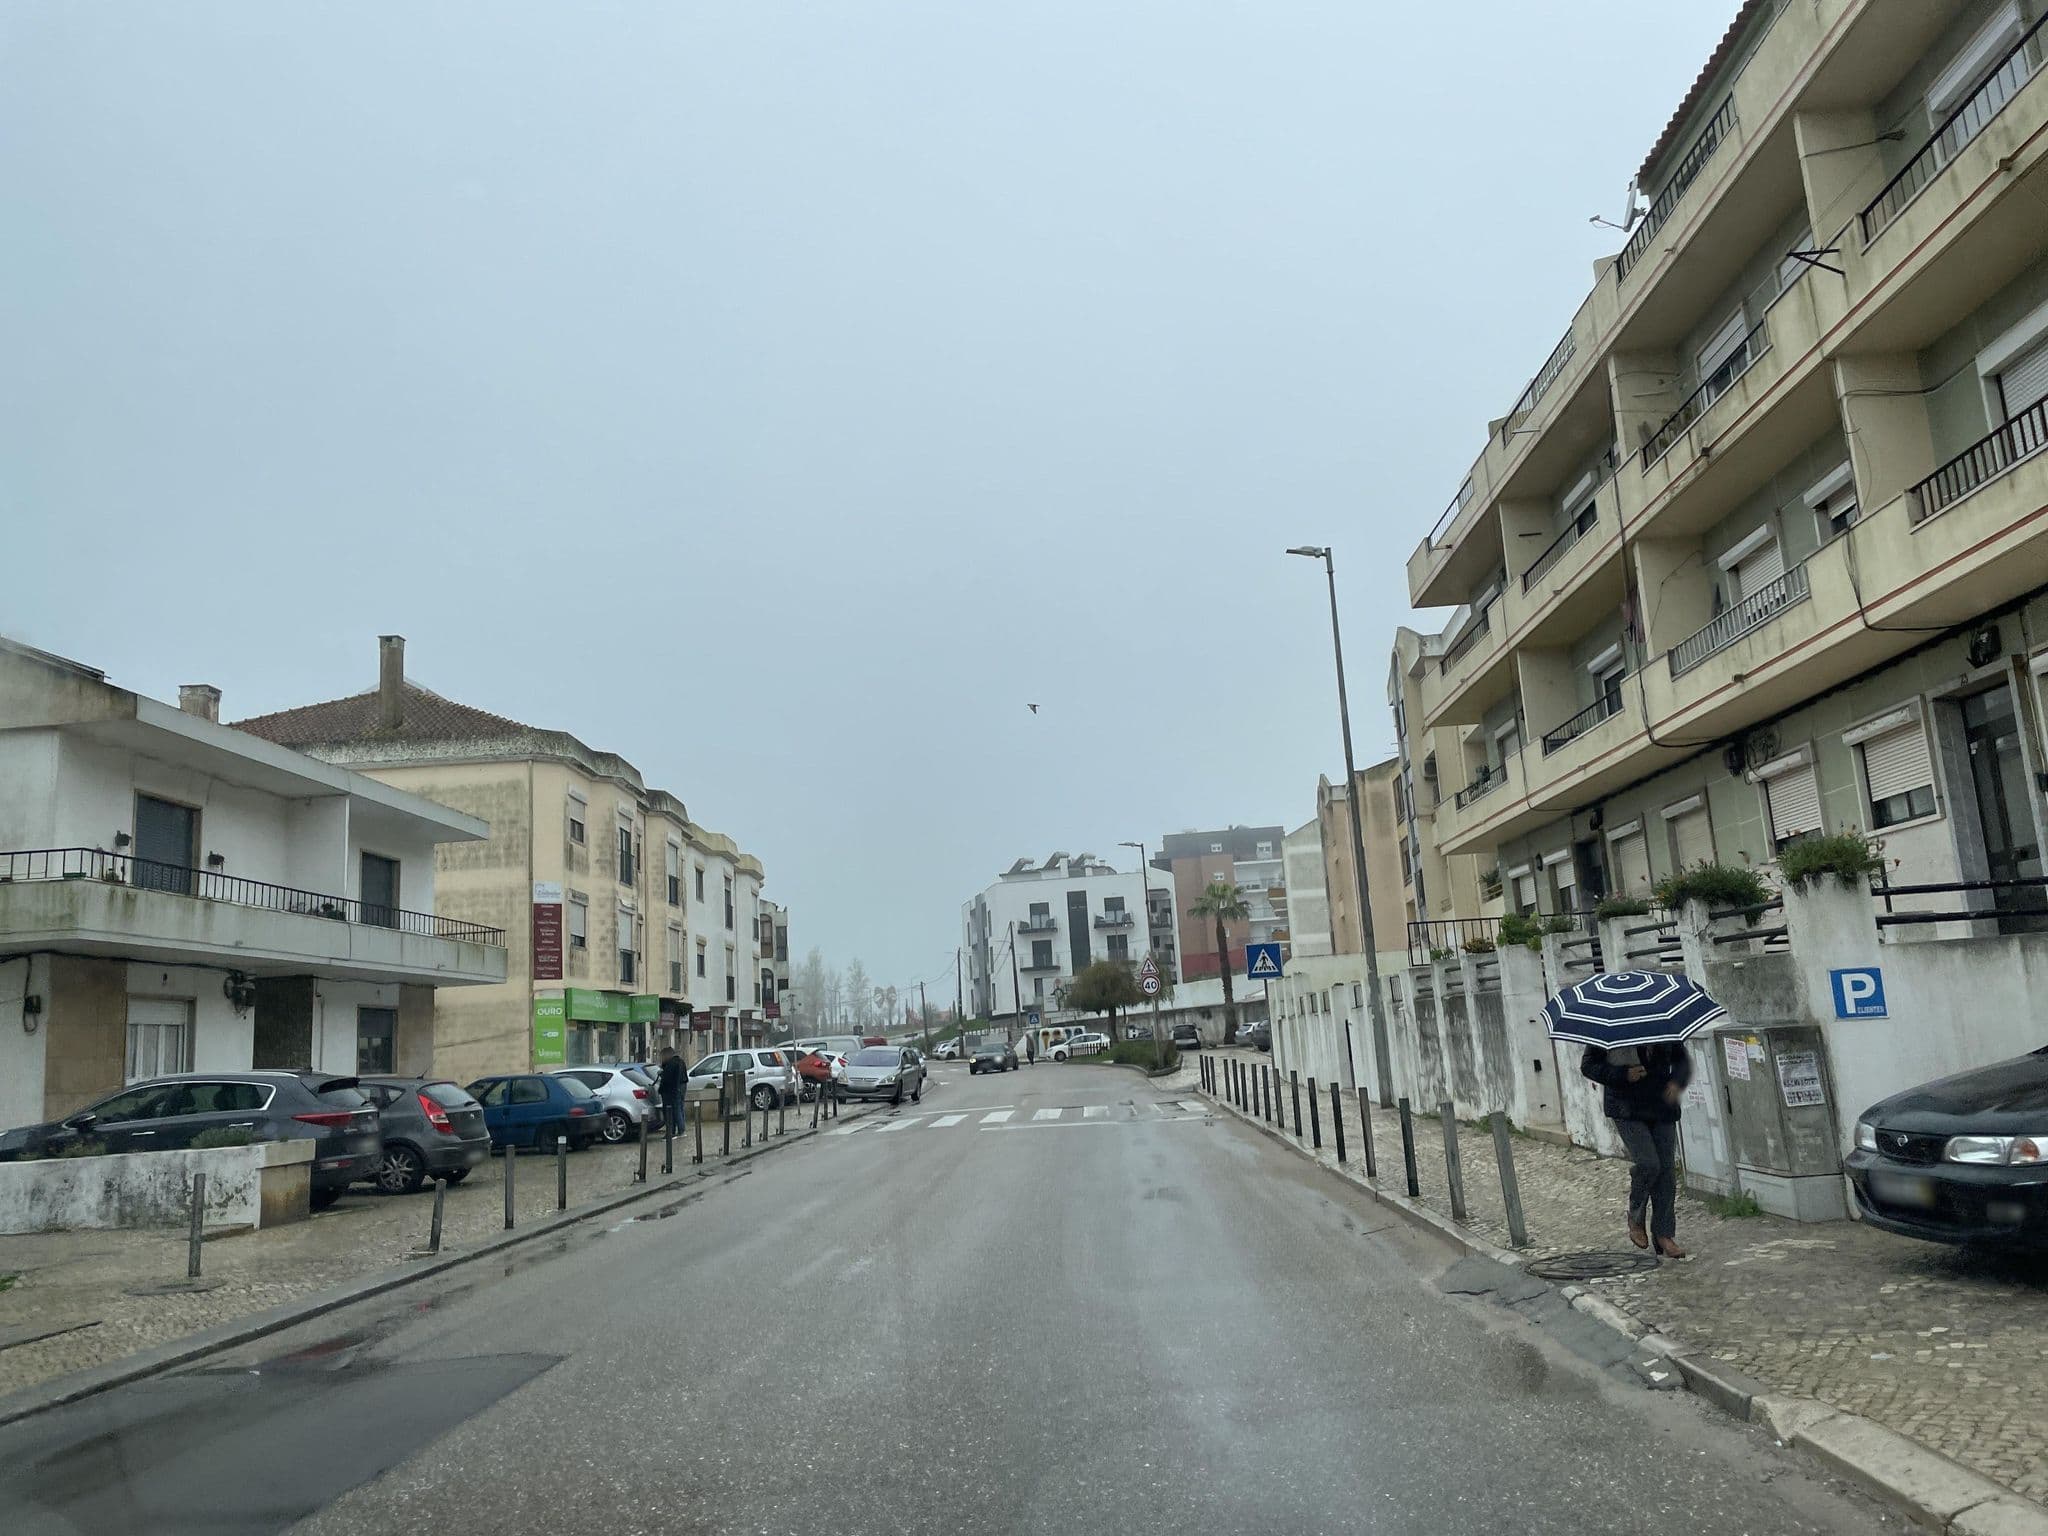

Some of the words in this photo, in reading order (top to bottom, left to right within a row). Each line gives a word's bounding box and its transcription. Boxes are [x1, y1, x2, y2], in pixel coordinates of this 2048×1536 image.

[1145, 981, 1157, 990] 40
[1842, 973, 1876, 1014] P
[537, 1007, 563, 1015] OURO
